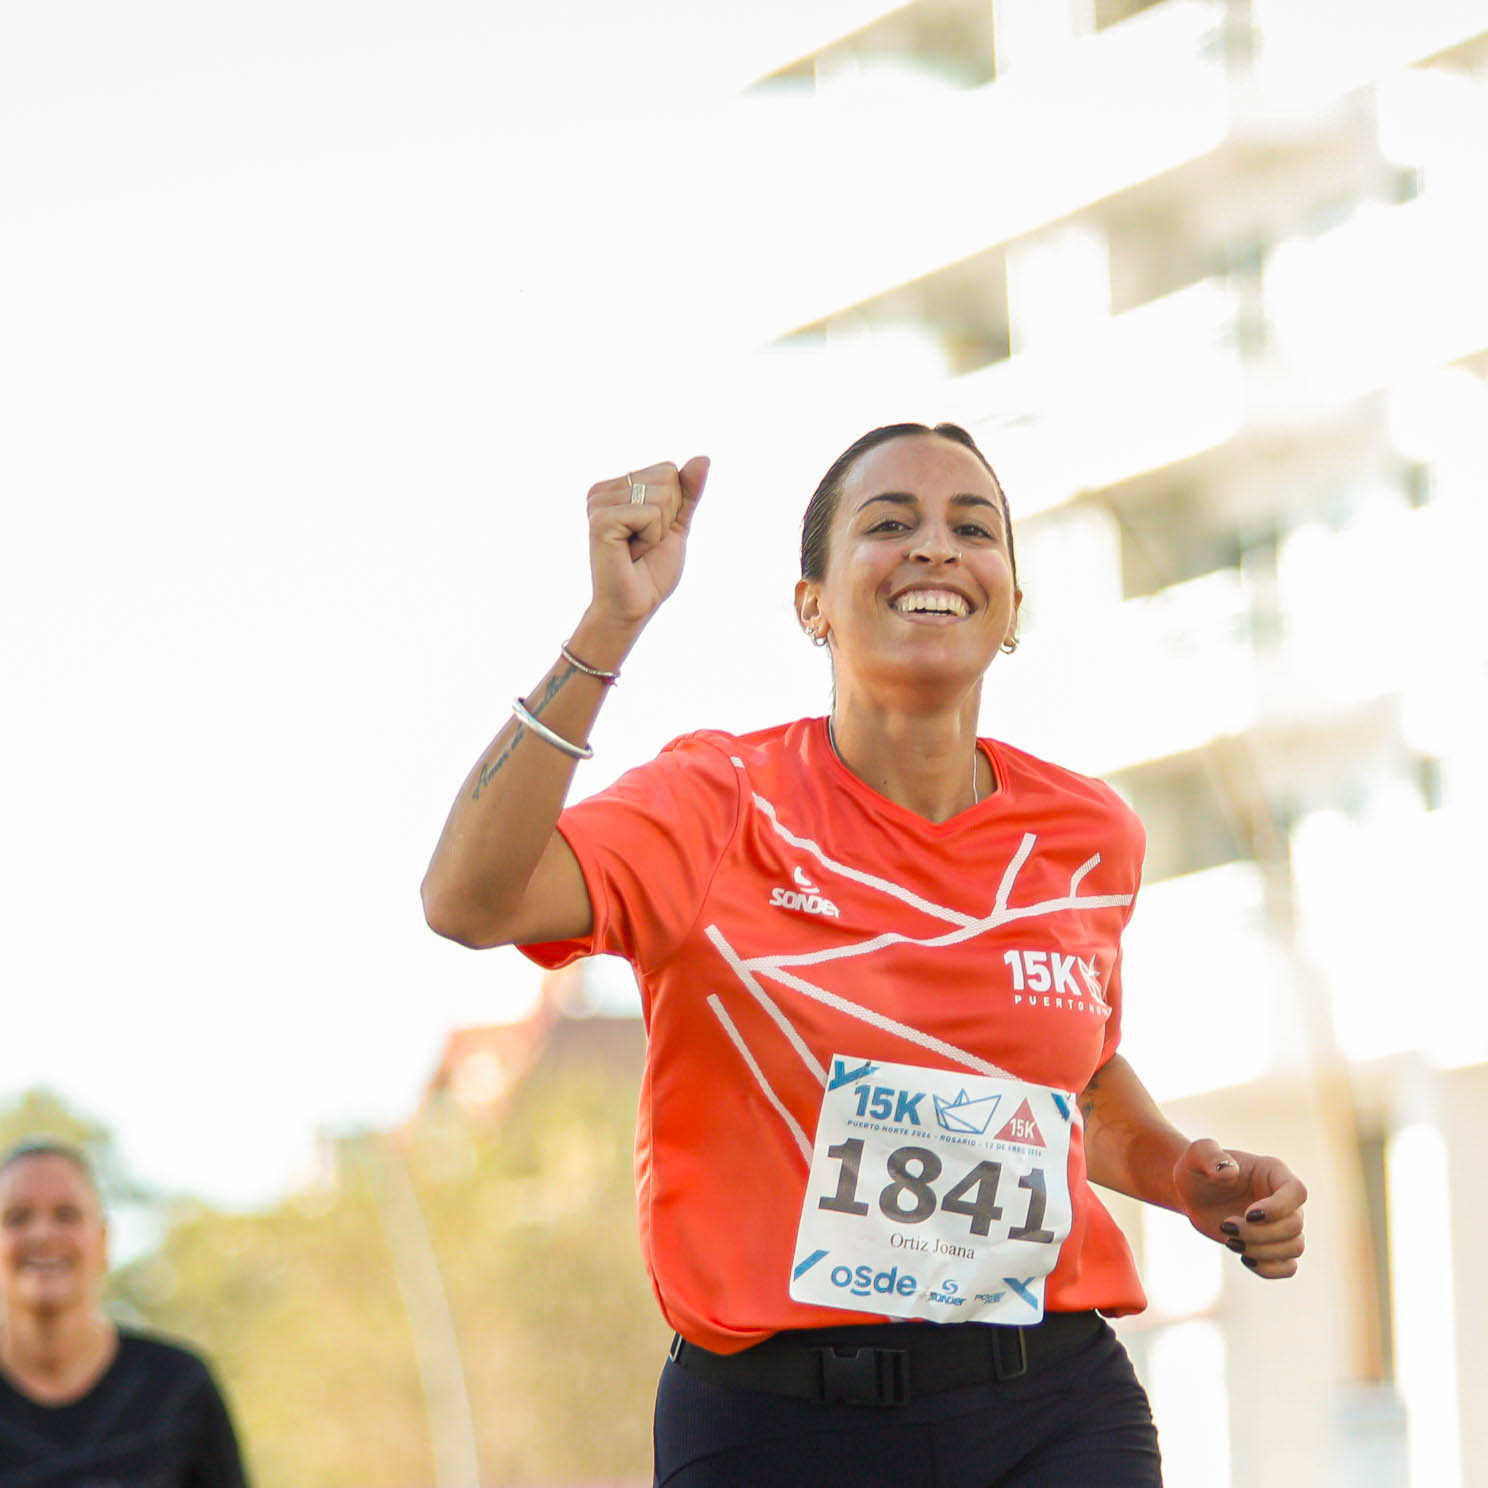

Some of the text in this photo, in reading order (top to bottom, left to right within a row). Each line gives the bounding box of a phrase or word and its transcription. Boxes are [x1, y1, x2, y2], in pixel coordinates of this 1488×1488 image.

[1003, 949, 1082, 996] 15K
[1014, 995, 1084, 1011] PUERTO
[854, 1084, 926, 1126] 15K
[1009, 1118, 1036, 1138] 15K
[818, 1138, 1055, 1243] 1841
[890, 1232, 975, 1260] Ortiz Joana
[830, 1264, 917, 1297] osde
